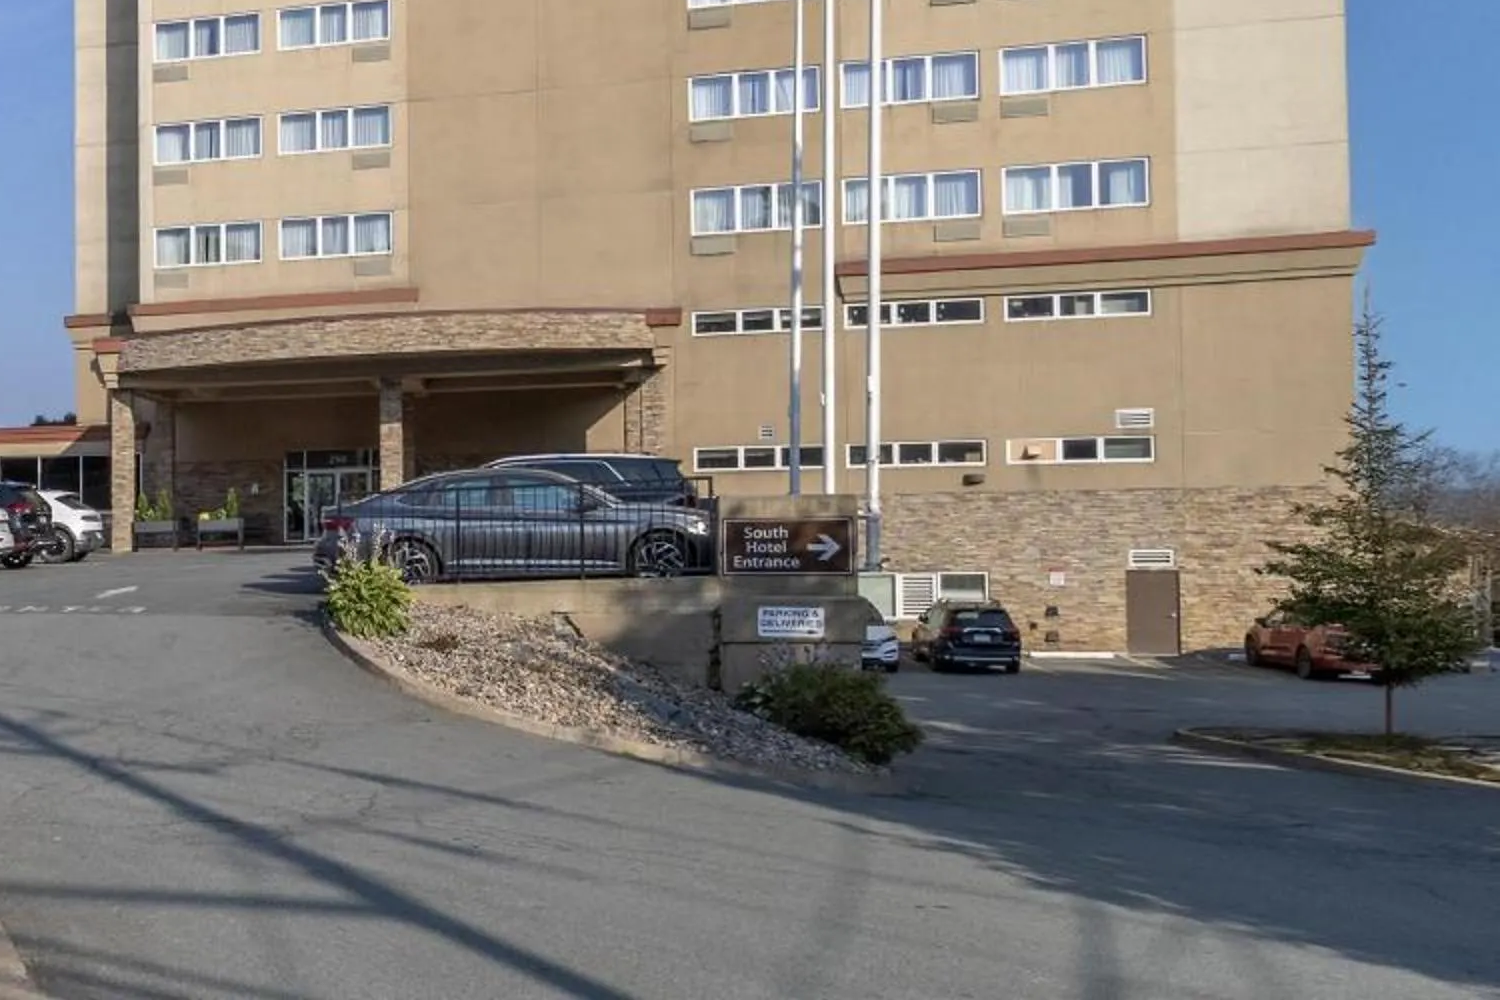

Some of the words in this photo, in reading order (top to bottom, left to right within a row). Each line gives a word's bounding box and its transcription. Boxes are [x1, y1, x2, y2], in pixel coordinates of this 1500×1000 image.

[743, 525, 789, 540] South
[745, 540, 787, 553] Hotel
[733, 555, 801, 569] Entrance
